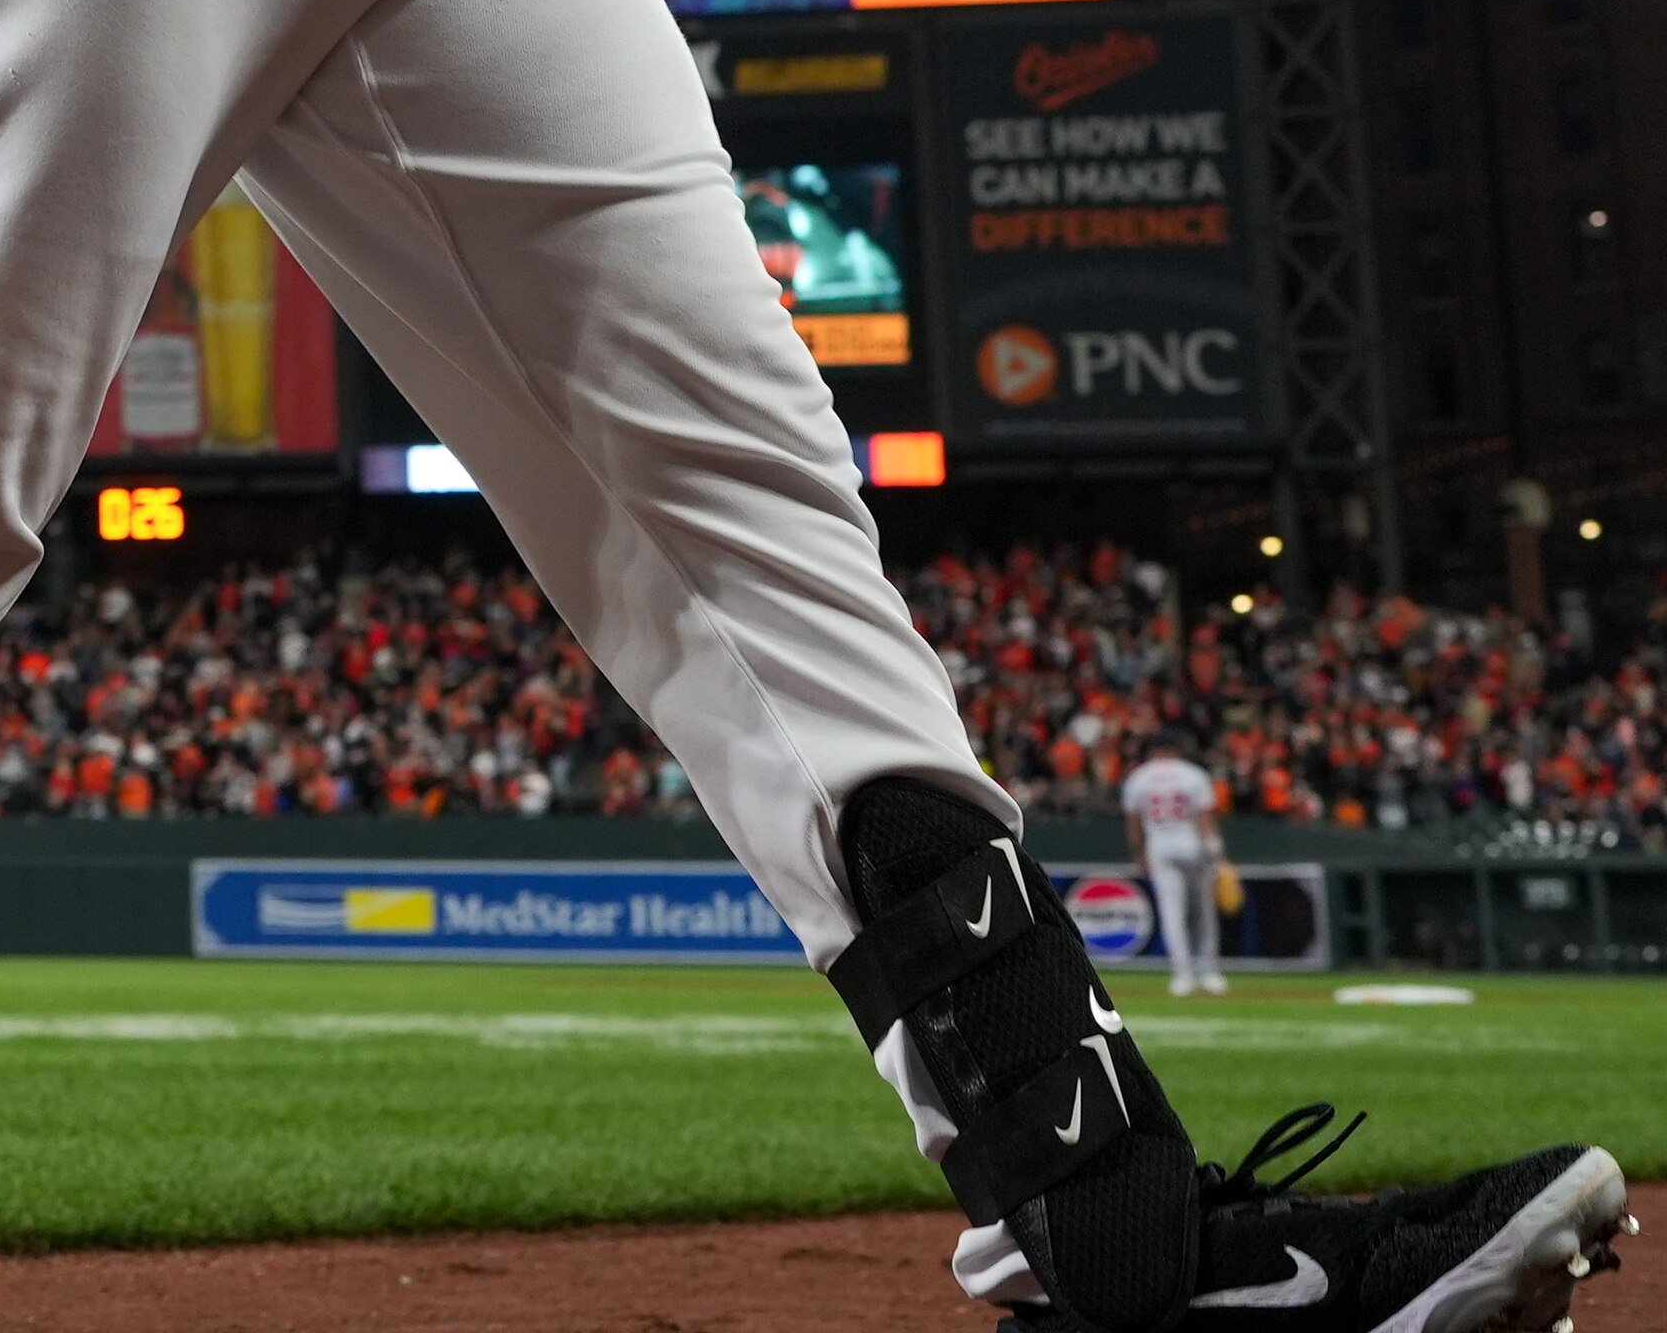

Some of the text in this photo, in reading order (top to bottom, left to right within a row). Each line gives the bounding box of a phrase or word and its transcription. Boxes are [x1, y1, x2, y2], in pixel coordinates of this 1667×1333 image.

[965, 110, 1226, 161] SEE HOW WE
[970, 157, 1226, 207] CAN MAKE A
[971, 203, 1229, 251] DIFFERENCE
[1068, 328, 1242, 396] PNC
[440, 888, 782, 937] MedStar Health
